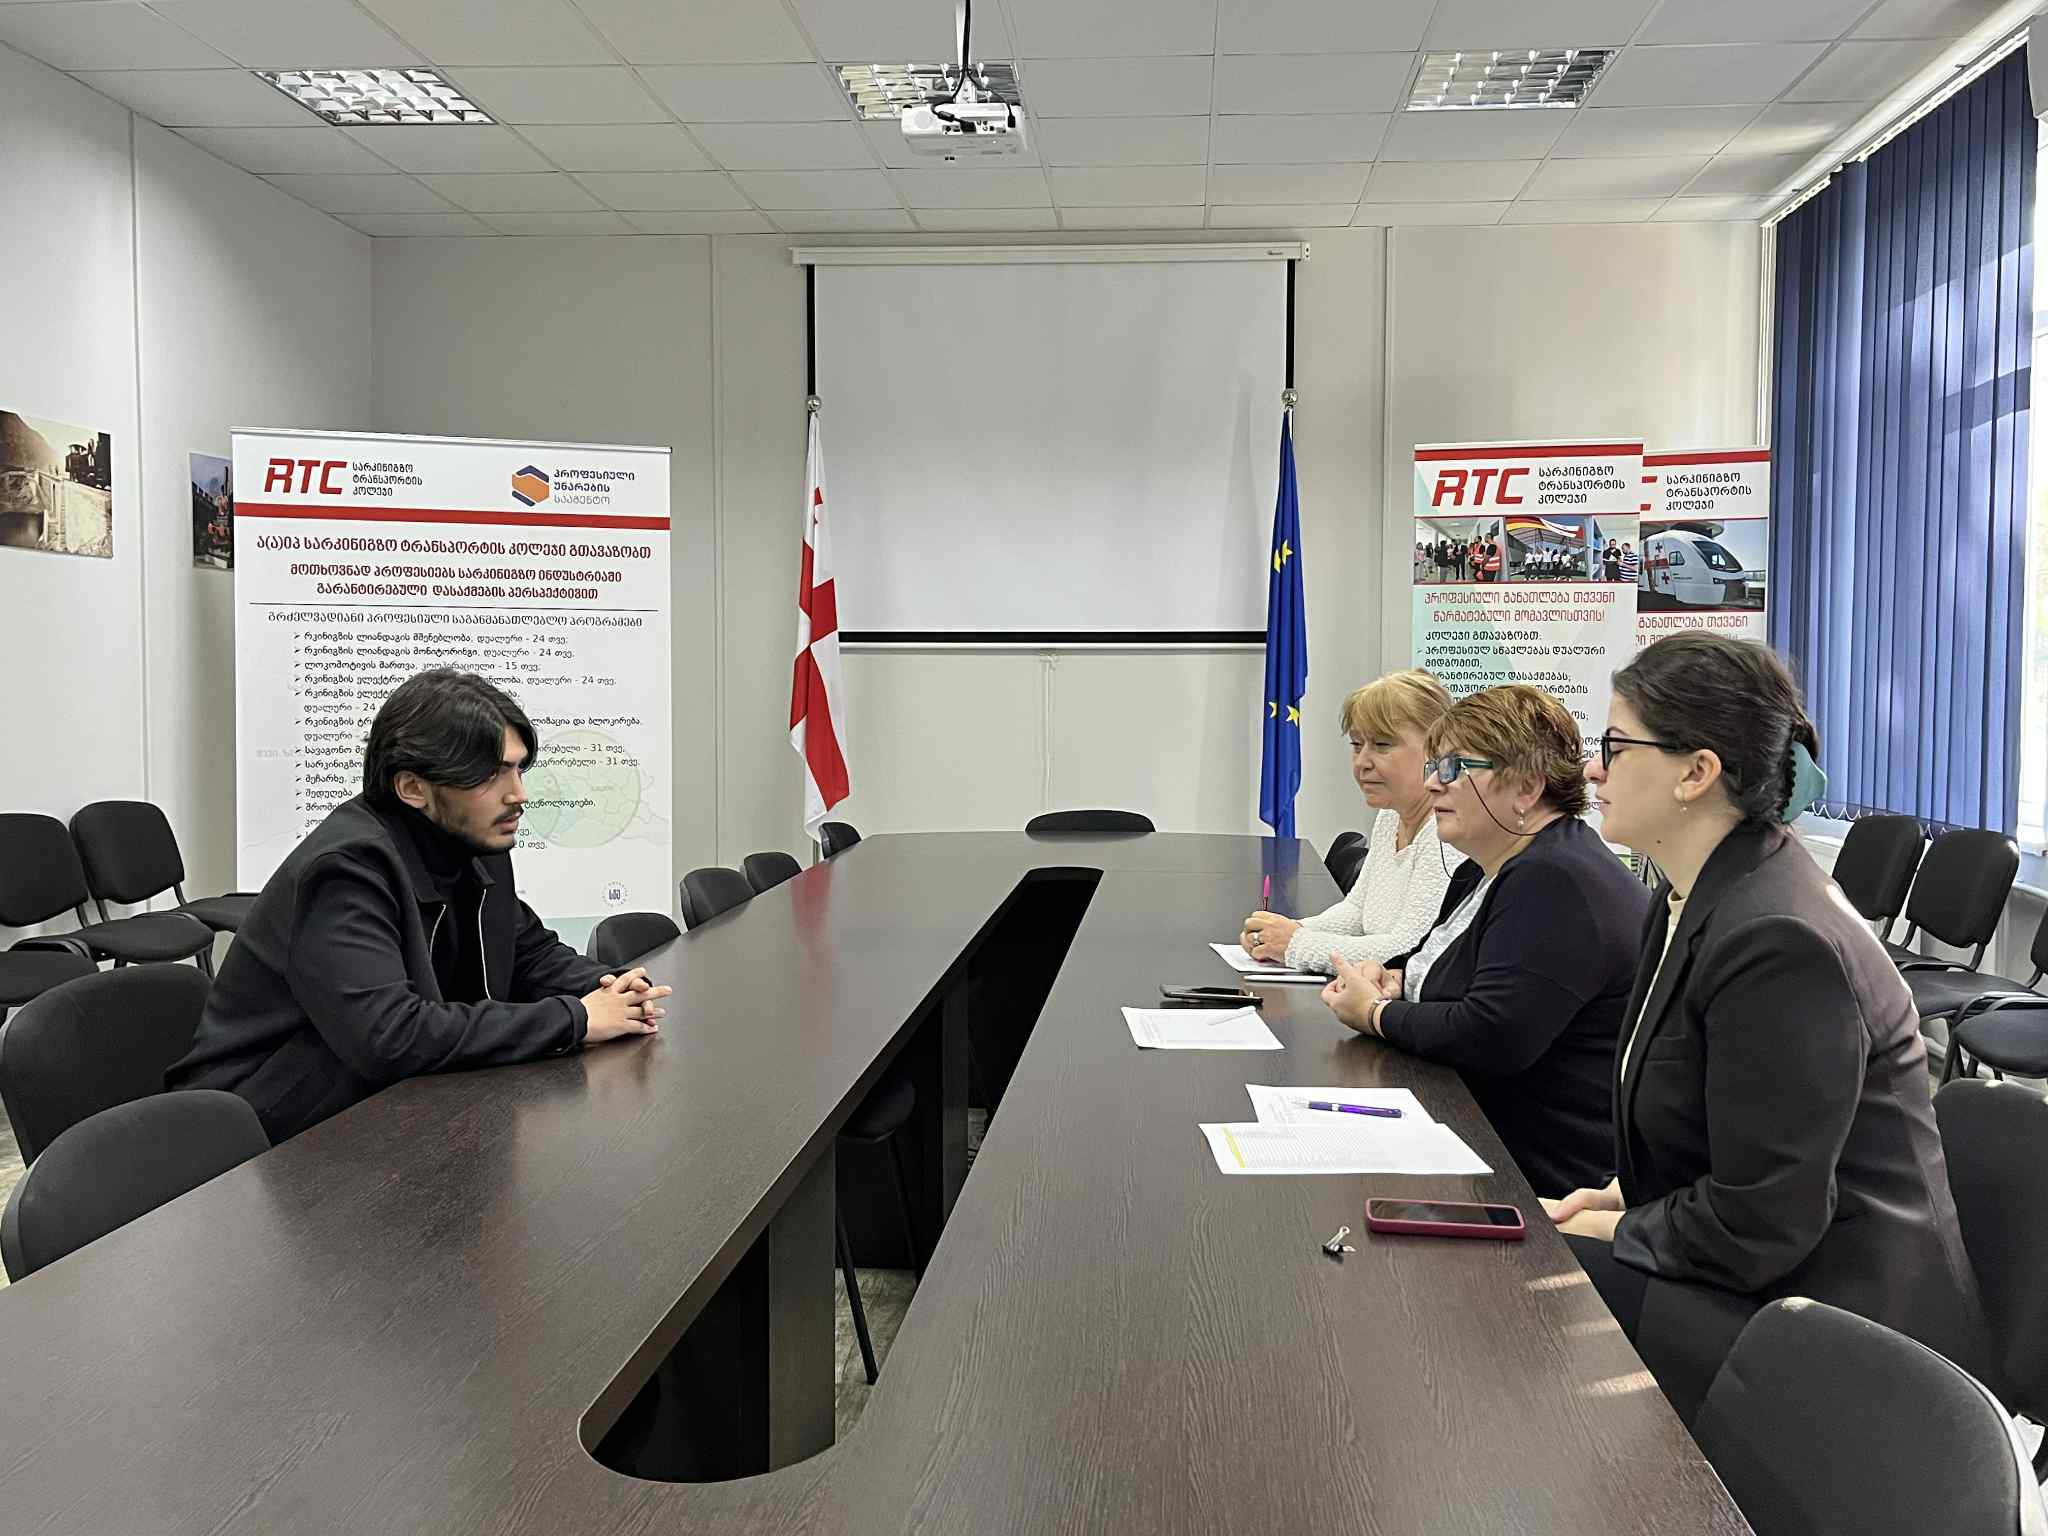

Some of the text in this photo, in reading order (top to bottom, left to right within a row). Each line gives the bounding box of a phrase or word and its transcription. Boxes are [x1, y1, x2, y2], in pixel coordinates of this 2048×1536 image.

[353, 462, 413, 473] სარკინიგზო
[1538, 466, 1614, 477] სარკინიგზო
[264, 458, 347, 494] RTC
[353, 475, 422, 485] ტრანსპორტის
[554, 469, 635, 481] პროფესიული
[1666, 472, 1740, 484] სარკინიგზო
[554, 482, 610, 492] უნარების
[1432, 468, 1530, 507] RTC
[1538, 479, 1625, 490] ტრანსპორტის
[353, 487, 393, 496] კოლეჯი
[1666, 485, 1752, 498] ტრანსპორტის
[554, 495, 610, 504] სააგენტო
[1538, 494, 1587, 504] კოლეჯი
[1666, 500, 1714, 510] კოლეჯი
[304, 537, 397, 552] სარკინიგზო
[401, 540, 505, 555] ტრანსპორტის
[509, 542, 565, 556] კოლეჯი
[570, 544, 651, 559] გთავაზობთ
[290, 564, 622, 582] მოთხოვნად პროფესიებს სარკინიგზო ინდუსტრიაში
[317, 583, 427, 596] გარანტირებული
[433, 585, 505, 598] დასაქმების
[367, 613, 449, 624] პროფესიული
[532, 634, 545, 643] 24
[539, 648, 551, 656] 24
[505, 661, 517, 670] 15
[582, 676, 594, 684] 24
[607, 757, 617, 765] 31
